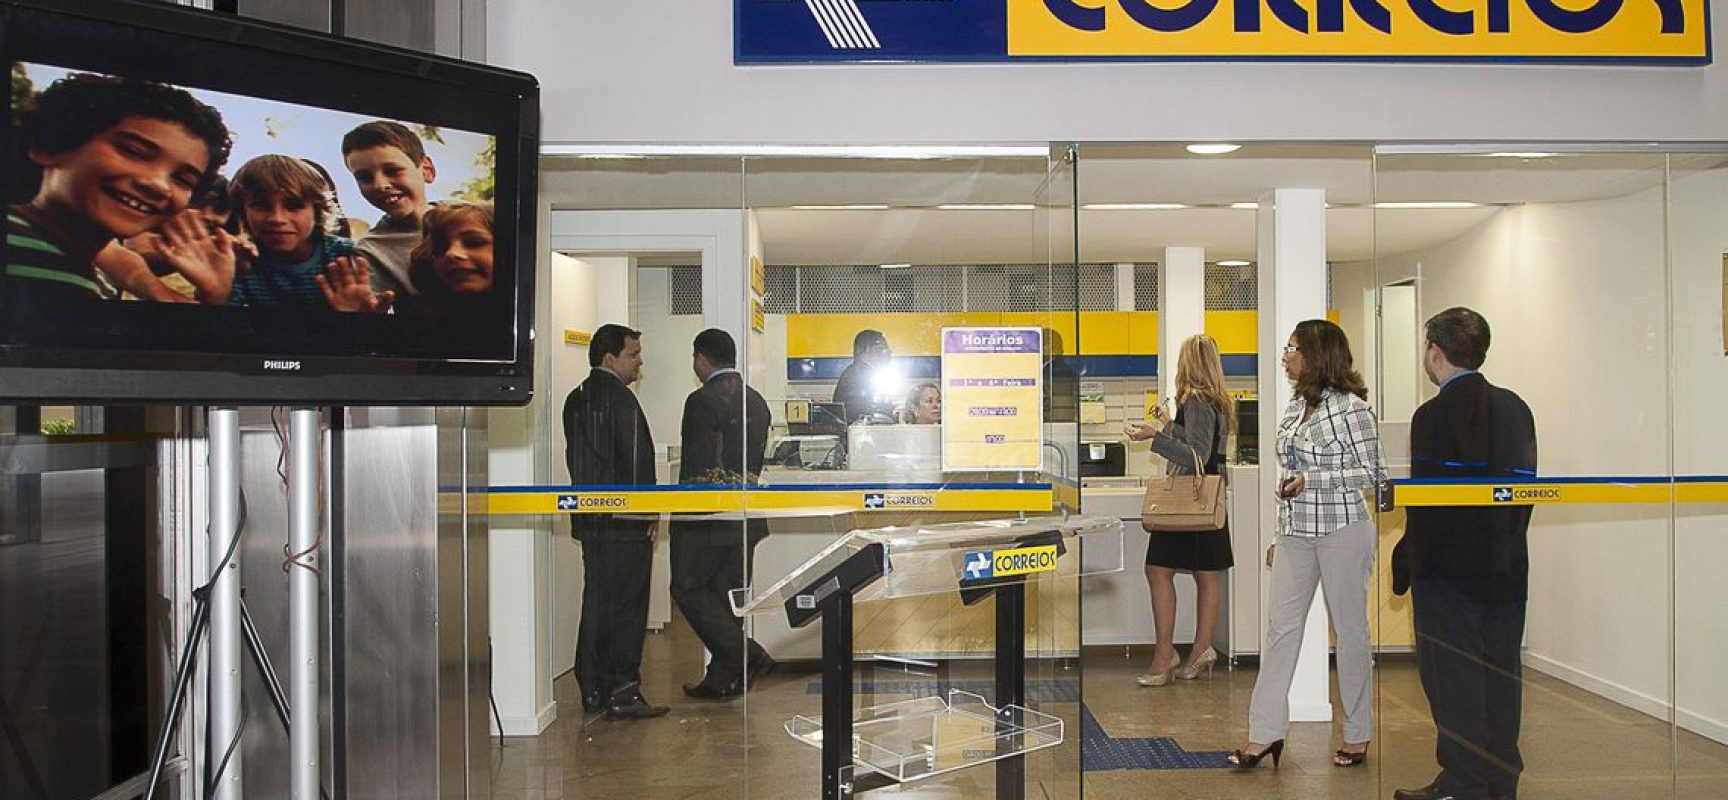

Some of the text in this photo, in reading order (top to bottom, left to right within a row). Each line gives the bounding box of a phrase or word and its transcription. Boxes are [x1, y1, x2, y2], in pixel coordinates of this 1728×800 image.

[962, 334, 1024, 345] Horários
[264, 360, 301, 370] PHILIPS
[1514, 489, 1559, 498] CORREIOS
[580, 498, 627, 507] CORREIOS
[886, 496, 933, 505] CORREIOS
[995, 551, 1056, 572] CORREIOS
